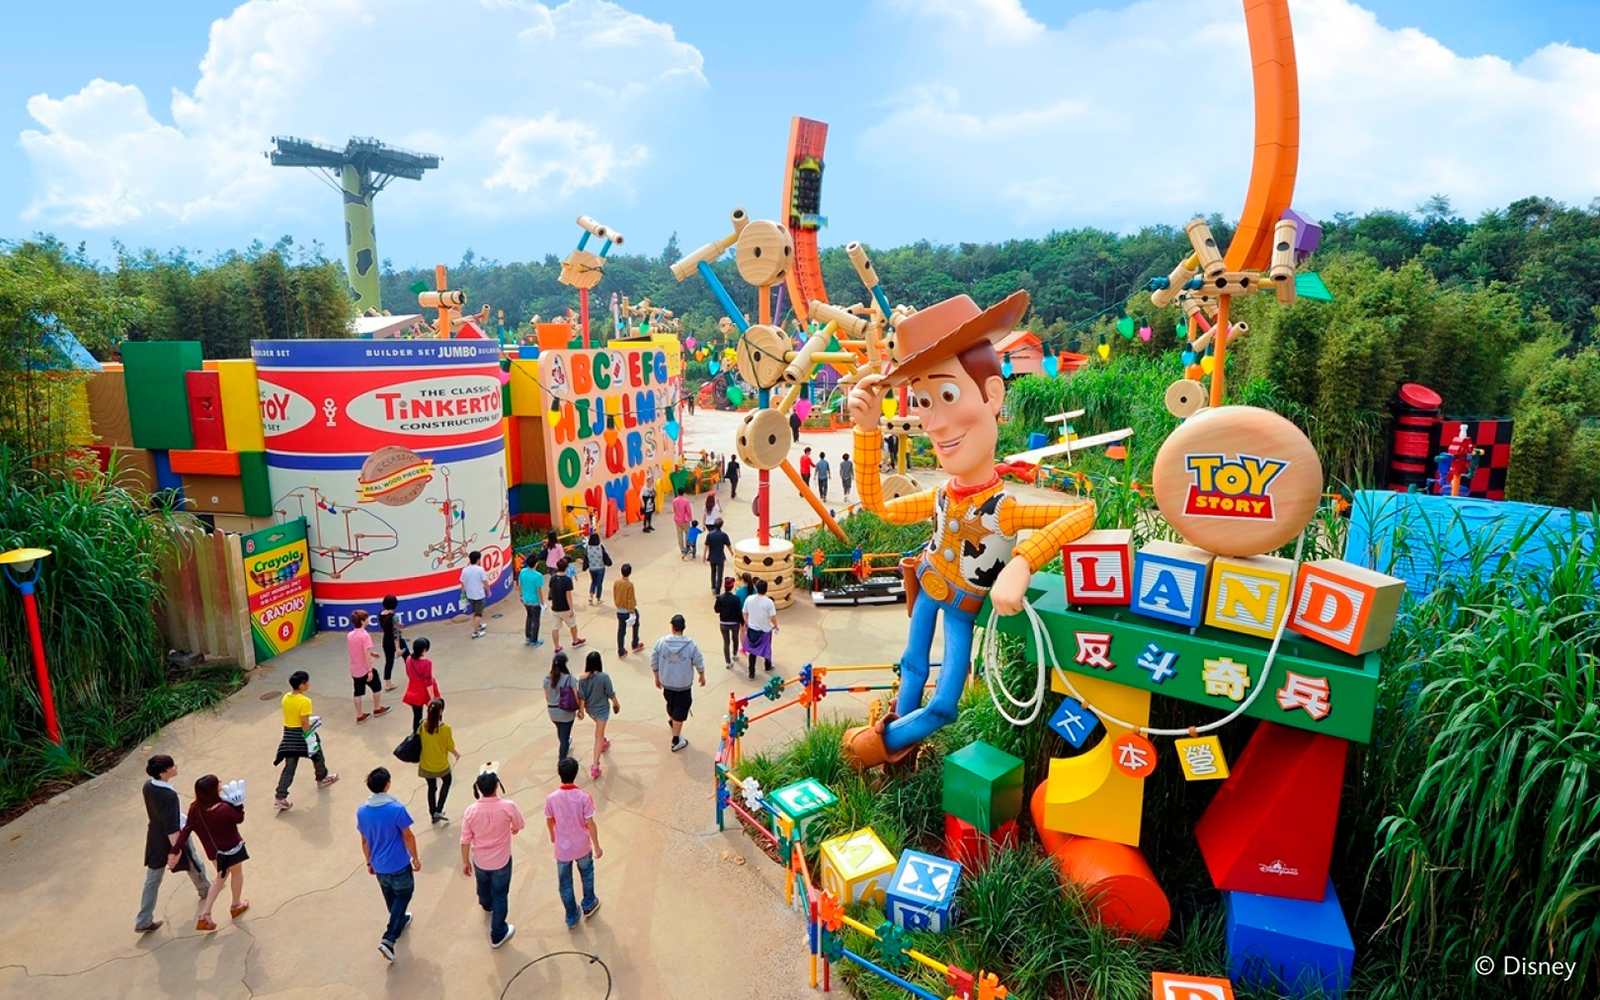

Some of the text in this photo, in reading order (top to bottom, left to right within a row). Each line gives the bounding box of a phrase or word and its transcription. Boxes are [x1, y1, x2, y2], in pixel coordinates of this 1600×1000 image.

[366, 349, 413, 357] BUILDER
[438, 346, 477, 358] JUMBO
[420, 385, 491, 397] THE CLASSIC
[400, 413, 500, 430] CONSTRUCTION SET
[383, 476, 402, 488] WOOD
[1195, 495, 1266, 514] STORY
[246, 540, 255, 553] 8
[254, 550, 300, 573] Crayola
[482, 550, 500, 573] 02
[486, 570, 500, 582] CES
[1076, 556, 1354, 631] LAND
[260, 597, 306, 626] CRAYONS
[327, 600, 465, 627] EDCTIONA
[282, 625, 290, 638] 8
[1074, 631, 1332, 721] 反斗奇兵
[903, 861, 950, 895] X
